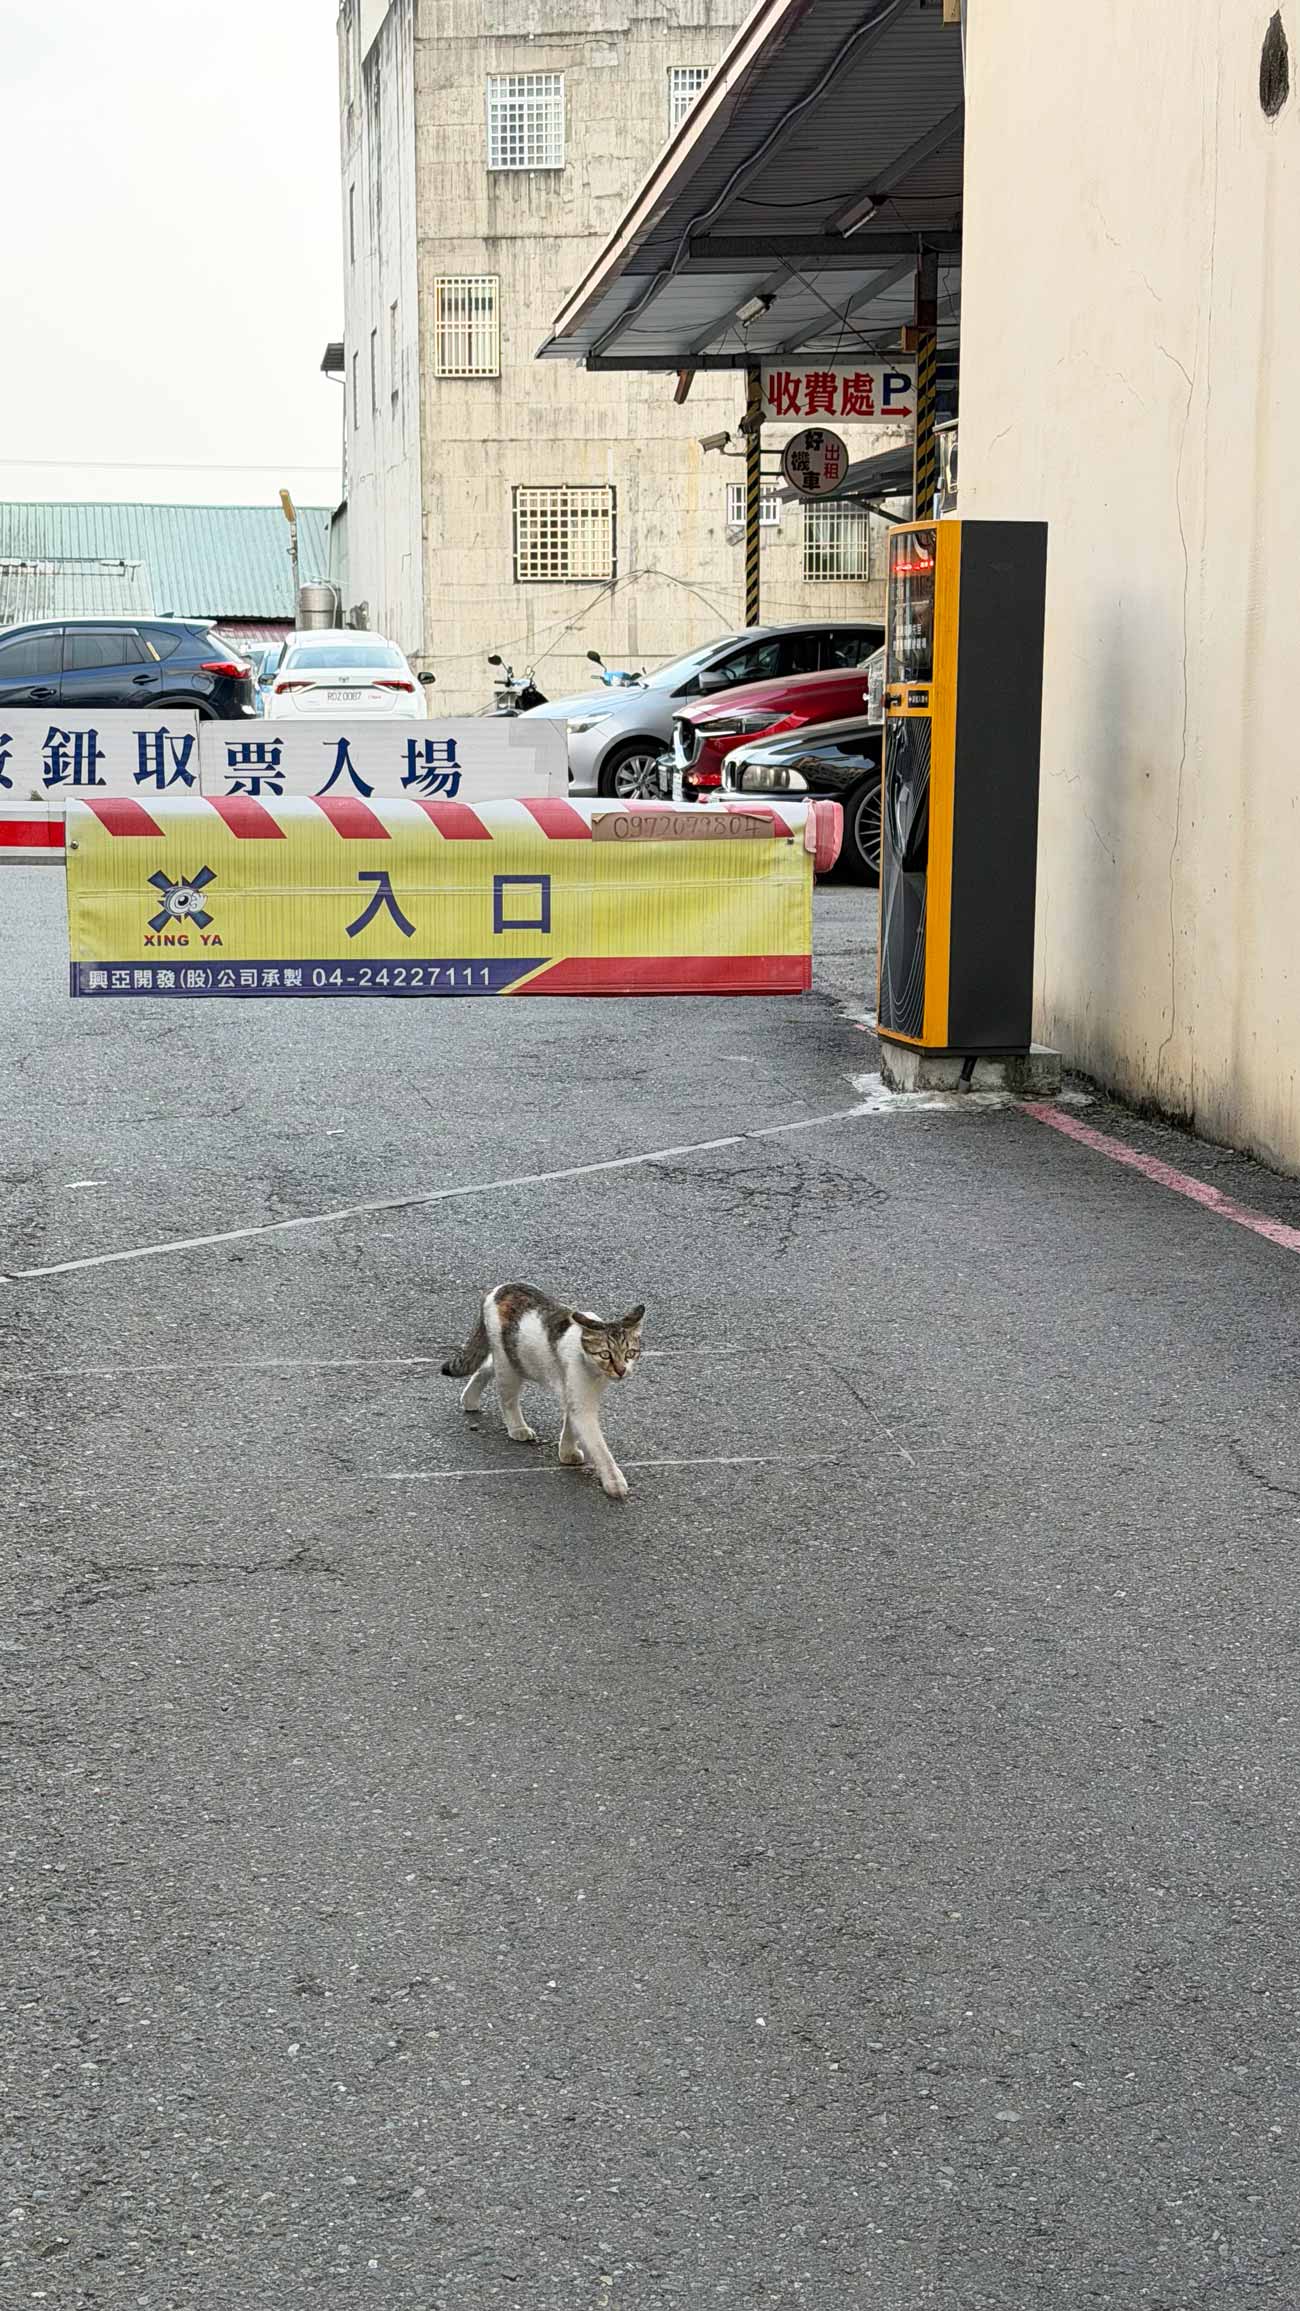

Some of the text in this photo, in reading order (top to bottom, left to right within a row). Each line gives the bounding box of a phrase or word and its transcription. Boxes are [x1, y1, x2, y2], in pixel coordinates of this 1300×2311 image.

[768, 371, 912, 417] 收費處 P
[824, 443, 840, 480] 出租
[346, 872, 552, 938] 入口
[143, 934, 223, 947] XING YA
[312, 967, 490, 987] 04-24227111
